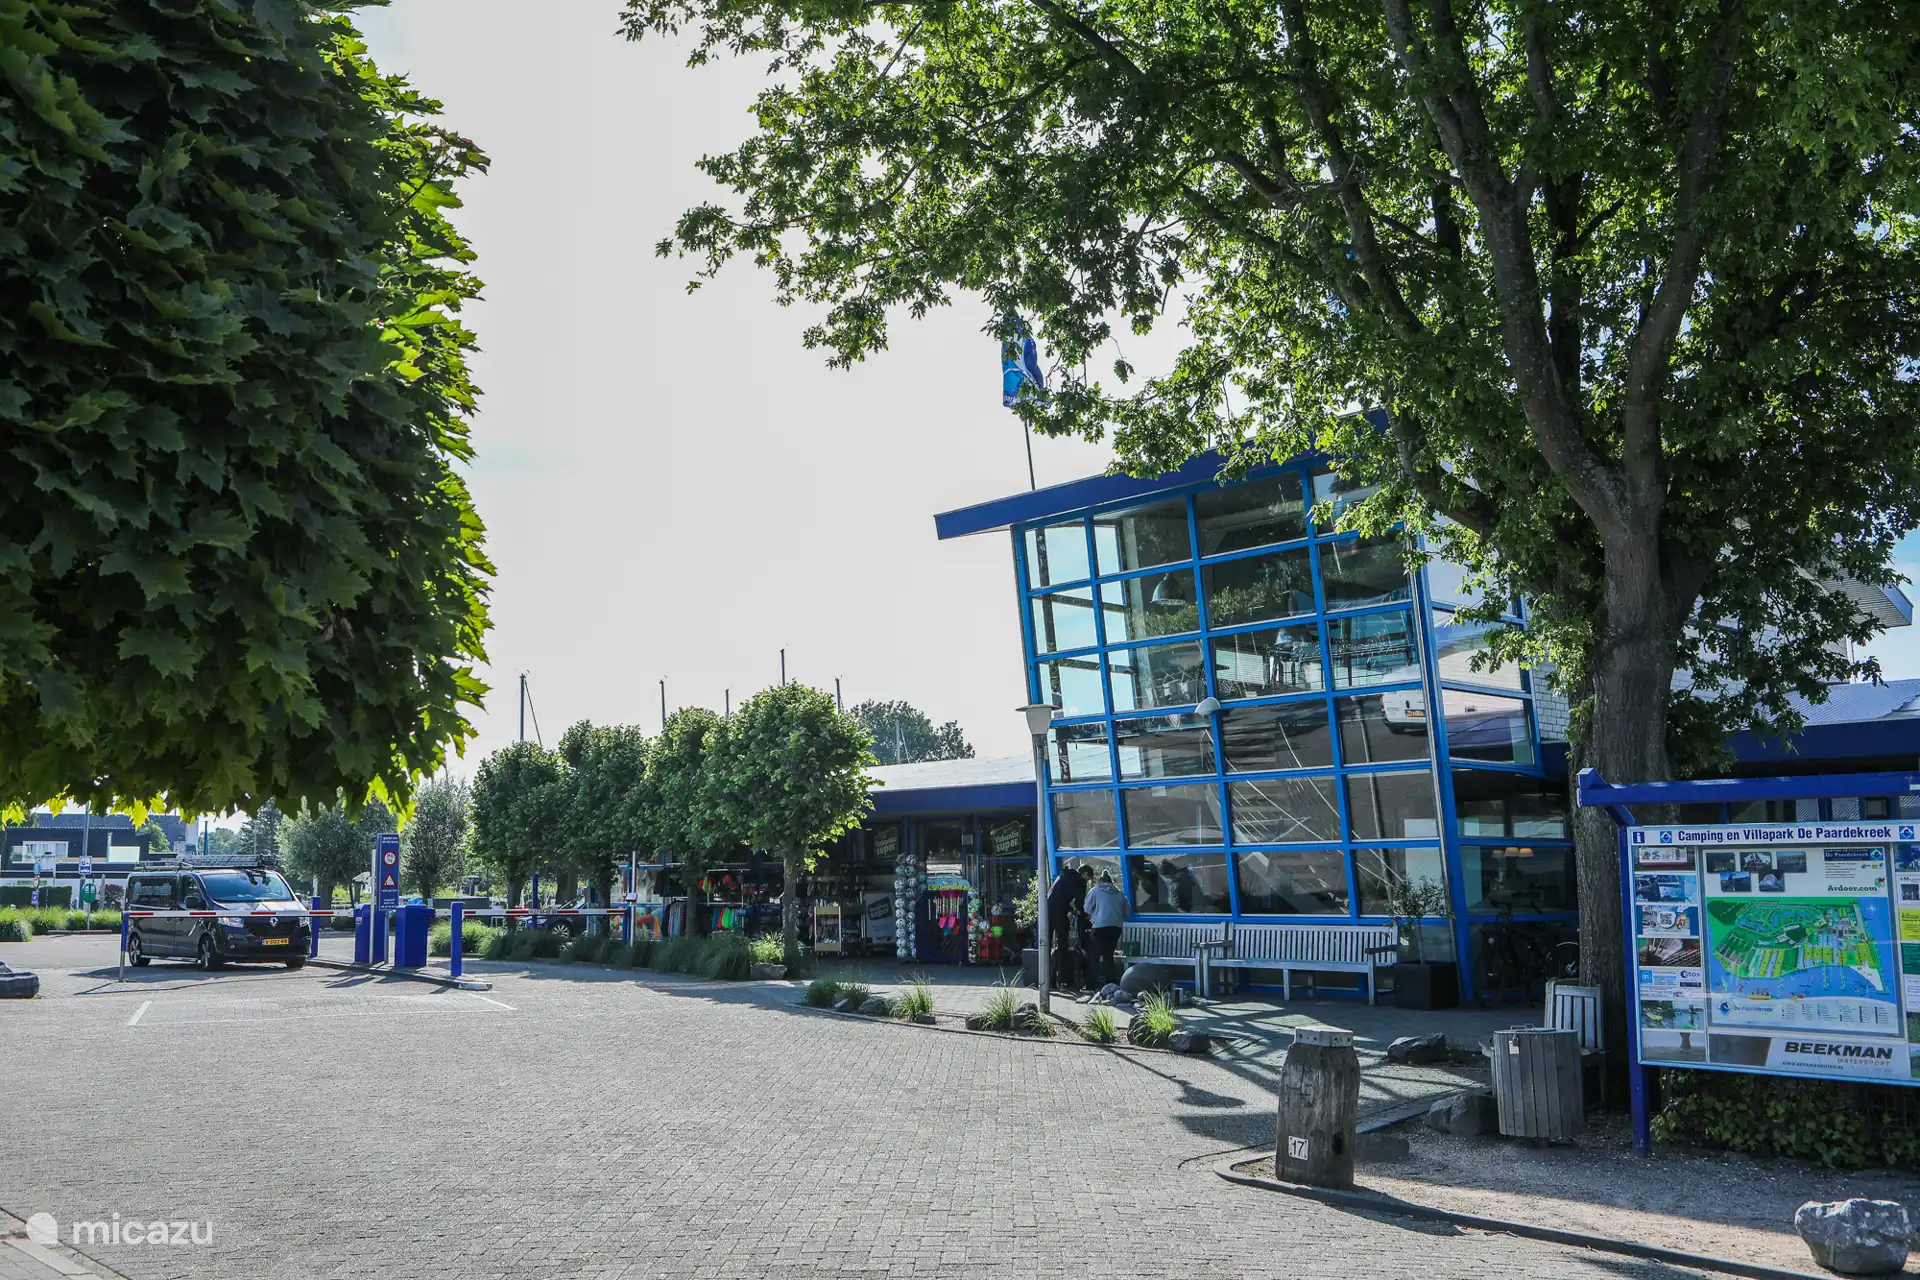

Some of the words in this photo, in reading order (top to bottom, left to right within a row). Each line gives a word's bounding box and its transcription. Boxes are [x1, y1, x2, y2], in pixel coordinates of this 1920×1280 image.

[1678, 830, 1723, 843] Camping
[1726, 831, 1740, 840] en
[1743, 828, 1794, 842] Villapark
[1798, 827, 1812, 839] De
[1816, 826, 1891, 838] Paardekreek
[876, 843, 895, 855] super
[996, 838, 1019, 852] super
[1827, 884, 1878, 892] Ardoer.com
[1784, 1041, 1893, 1060] BEEKMAN
[1836, 1057, 1891, 1067] WATERSPORT
[1292, 1140, 1305, 1156] 17
